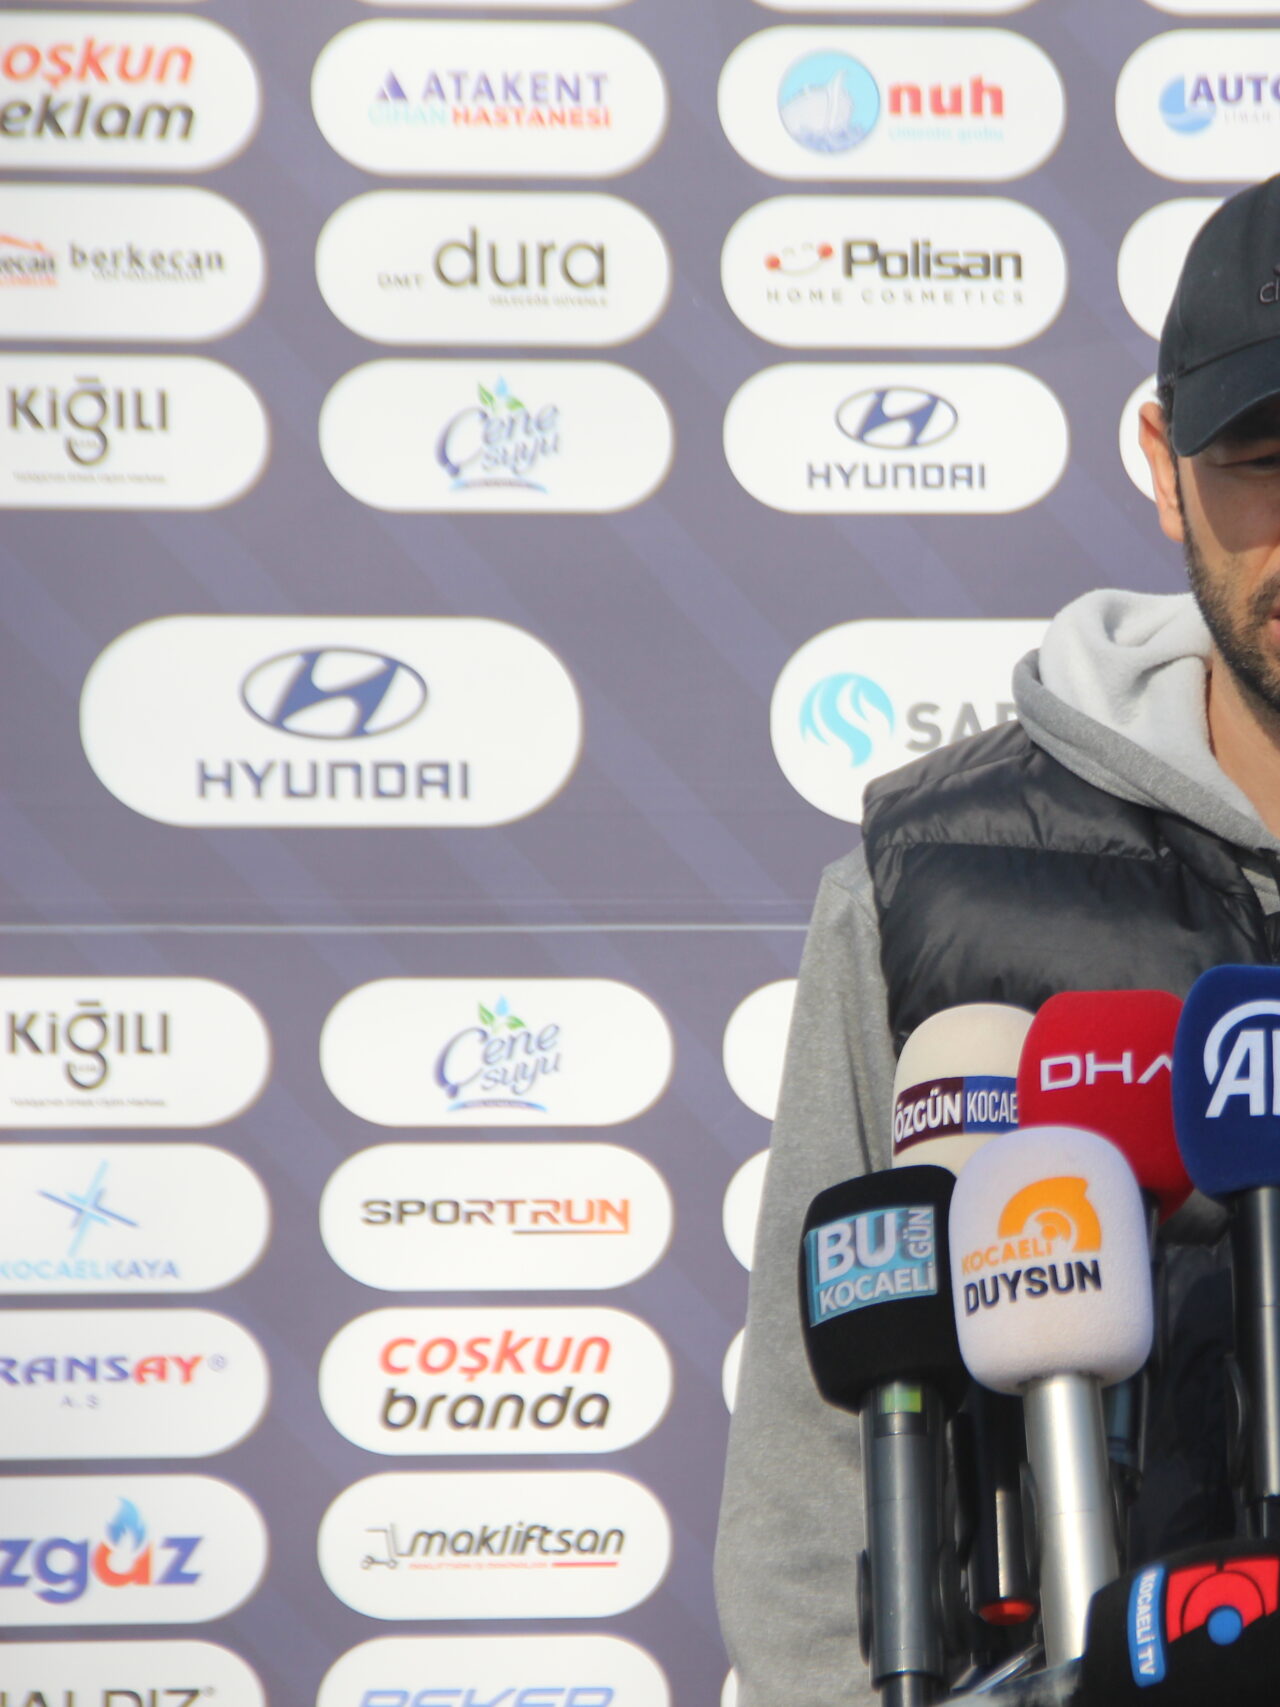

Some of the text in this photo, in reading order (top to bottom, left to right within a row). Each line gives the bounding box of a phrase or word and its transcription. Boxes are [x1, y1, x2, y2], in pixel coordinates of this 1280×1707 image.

[420, 70, 610, 104] ATAKENT
[888, 75, 1004, 117] nuh
[68, 243, 226, 273] berkecan
[433, 225, 608, 290] dura
[843, 238, 1025, 281] Polisan
[766, 288, 1024, 306] HOME COSMETICS
[806, 461, 987, 490] HYUNDAI
[196, 759, 470, 800] HYUNDAI
[1040, 1051, 1172, 1092] DHA
[894, 1084, 962, 1144] ÖZGÜN
[360, 1198, 630, 1232] SPORTRUN
[902, 1207, 933, 1260] GÜN
[817, 1212, 897, 1285] BU
[818, 1260, 938, 1317] KOCAELİ
[963, 1258, 1103, 1318] DUYSUN
[378, 1329, 613, 1382] coşkun
[378, 1386, 611, 1433] branda
[406, 1520, 626, 1557] makliftsan
[1136, 1649, 1157, 1676] TV
